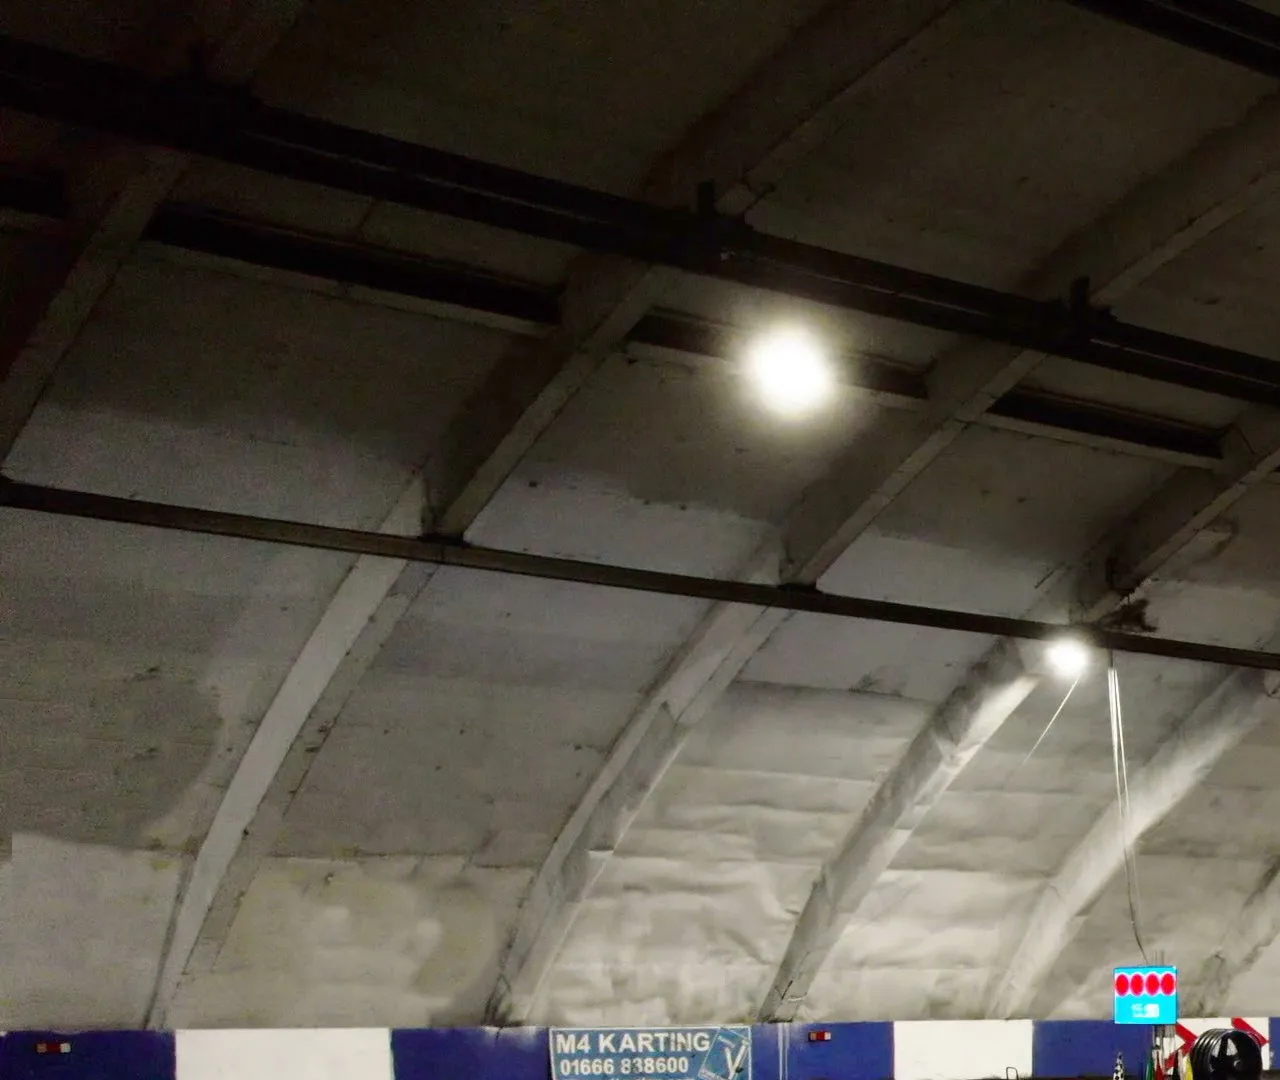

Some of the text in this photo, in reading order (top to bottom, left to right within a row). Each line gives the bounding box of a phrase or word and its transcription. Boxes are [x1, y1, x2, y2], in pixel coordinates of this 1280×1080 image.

[556, 1032, 711, 1054] M4 KARTING
[559, 1056, 689, 1075] 01666 838600
